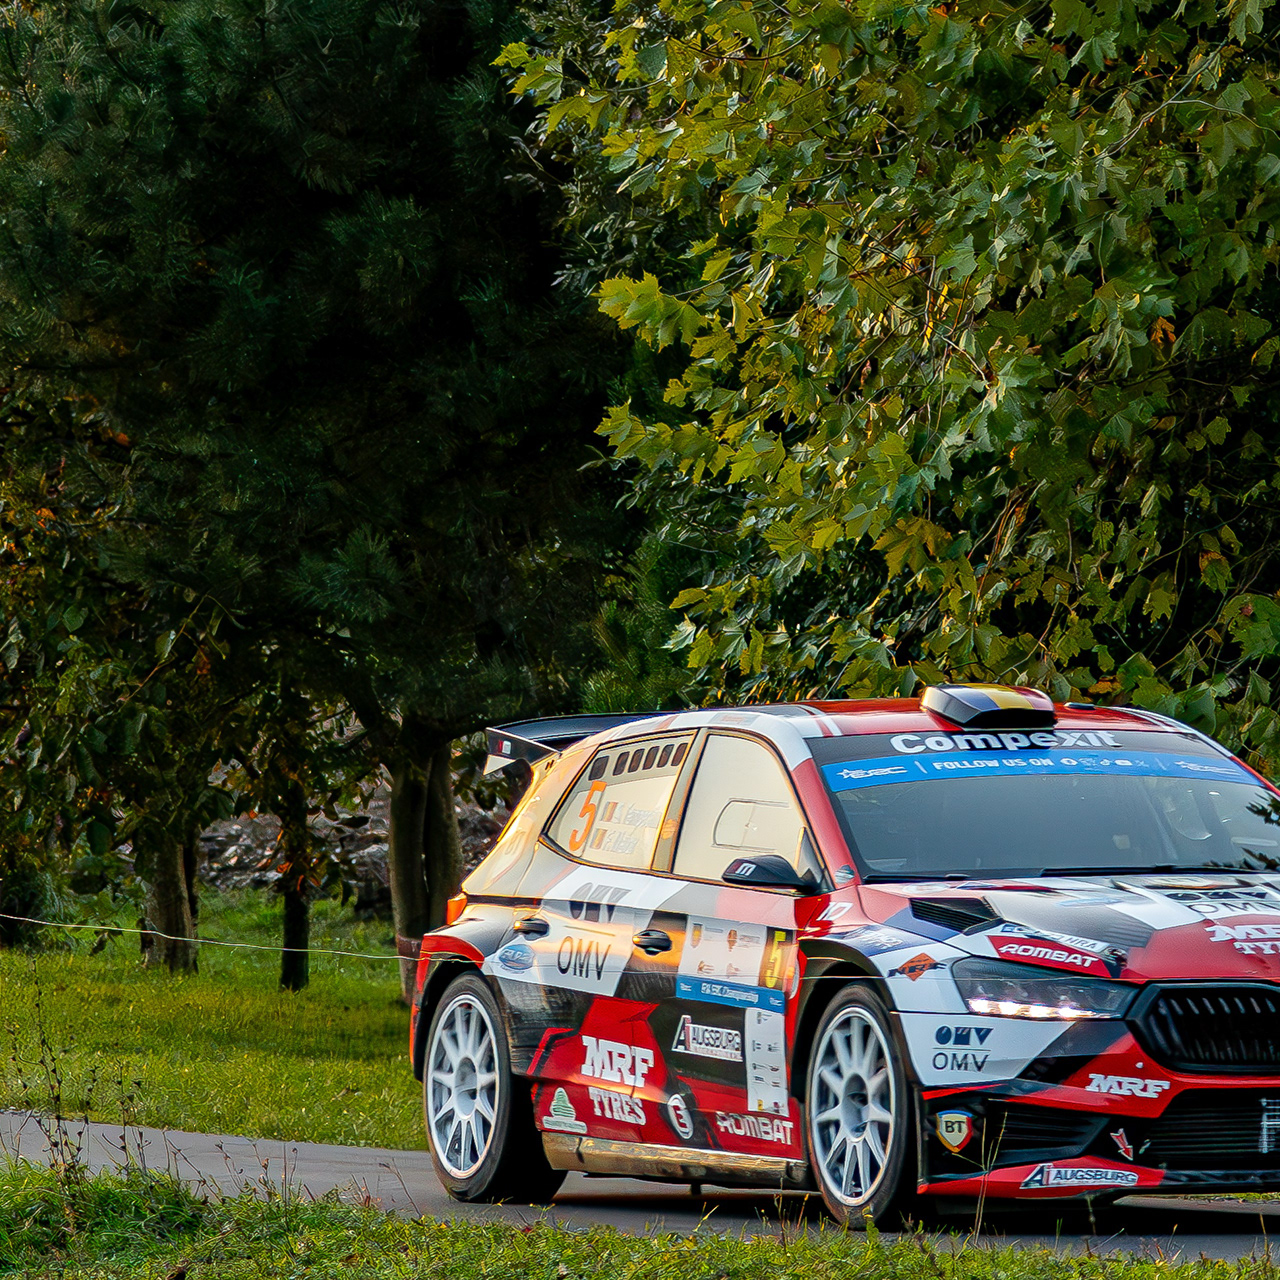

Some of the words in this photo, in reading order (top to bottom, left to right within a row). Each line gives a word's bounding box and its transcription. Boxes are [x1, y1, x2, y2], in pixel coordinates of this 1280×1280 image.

[889, 730, 1123, 754] Compexit
[932, 759, 1000, 770] FOLLOW
[1002, 758, 1028, 767] US
[1028, 757, 1055, 766] ON
[568, 780, 608, 852] 5
[557, 935, 612, 981] OMV
[764, 930, 787, 988] 5
[998, 943, 1099, 968] ROMBAT
[691, 1026, 742, 1052] AUGSBURG
[581, 1035, 655, 1088] MRF
[931, 1052, 991, 1073] OMV
[1084, 1073, 1171, 1099] MRF
[588, 1086, 647, 1126] TYRES
[715, 1111, 794, 1146] ROMBAT
[943, 1119, 966, 1134] BT
[1052, 1169, 1138, 1183] AUGSBURG
